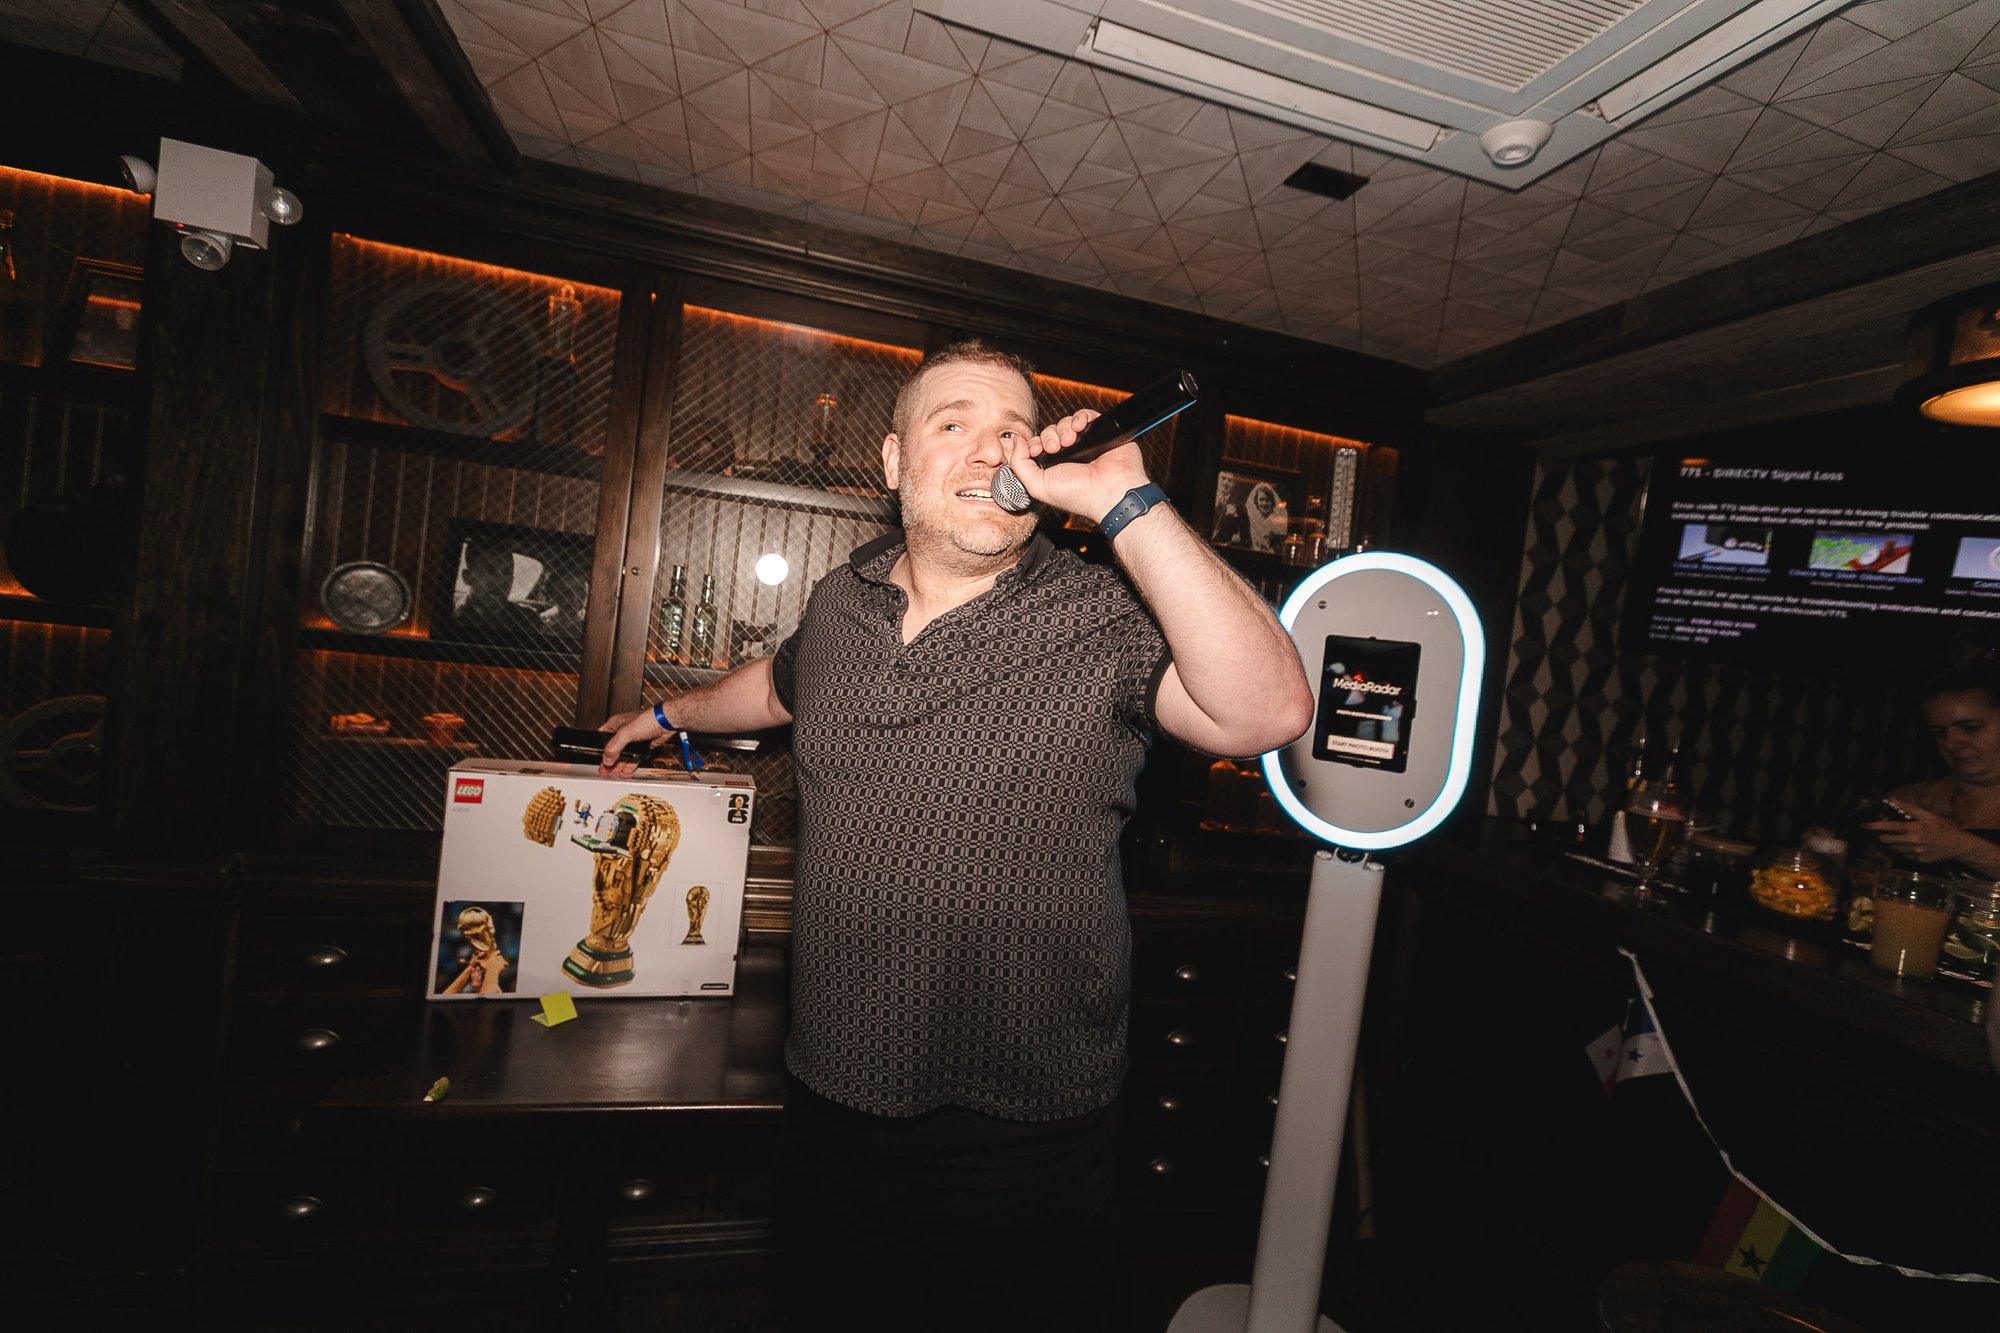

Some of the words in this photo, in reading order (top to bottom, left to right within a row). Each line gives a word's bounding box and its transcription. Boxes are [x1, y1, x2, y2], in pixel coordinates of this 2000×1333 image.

[1713, 468, 1769, 480] DIRECTV
[1770, 469, 1812, 482] Signal
[1813, 471, 1845, 481] Loss
[1672, 501, 1695, 510] Error
[1738, 503, 1780, 513] indicates
[1781, 506, 1803, 515] your
[1803, 507, 1843, 515] receiver
[1844, 508, 1854, 516] is
[1855, 509, 1889, 518] having
[1890, 510, 1929, 518] trouble
[1671, 512, 1706, 520] satellite
[1728, 514, 1760, 523] Follow
[1761, 516, 1788, 524] these
[1789, 517, 1815, 526] steps
[1816, 518, 1828, 526] to
[1829, 519, 1865, 527] correct
[1865, 520, 1884, 528] the
[1788, 568, 1818, 577] Check
[1820, 570, 1833, 578] for
[1834, 572, 1858, 580] Dish
[1858, 574, 1925, 584] Obstructions
[1656, 586, 1681, 595] Press
[1682, 588, 1715, 597] SELECT
[1728, 592, 1750, 600] your
[1785, 595, 1800, 604] for
[1800, 597, 1878, 611] troubleshooting
[1878, 603, 1940, 615] instructions
[1940, 607, 1962, 616] and
[1332, 677, 1401, 696] MediaRadar
[1331, 740, 1349, 748] START
[1369, 745, 1390, 753] BOOTH
[456, 785, 482, 797] LEGO
